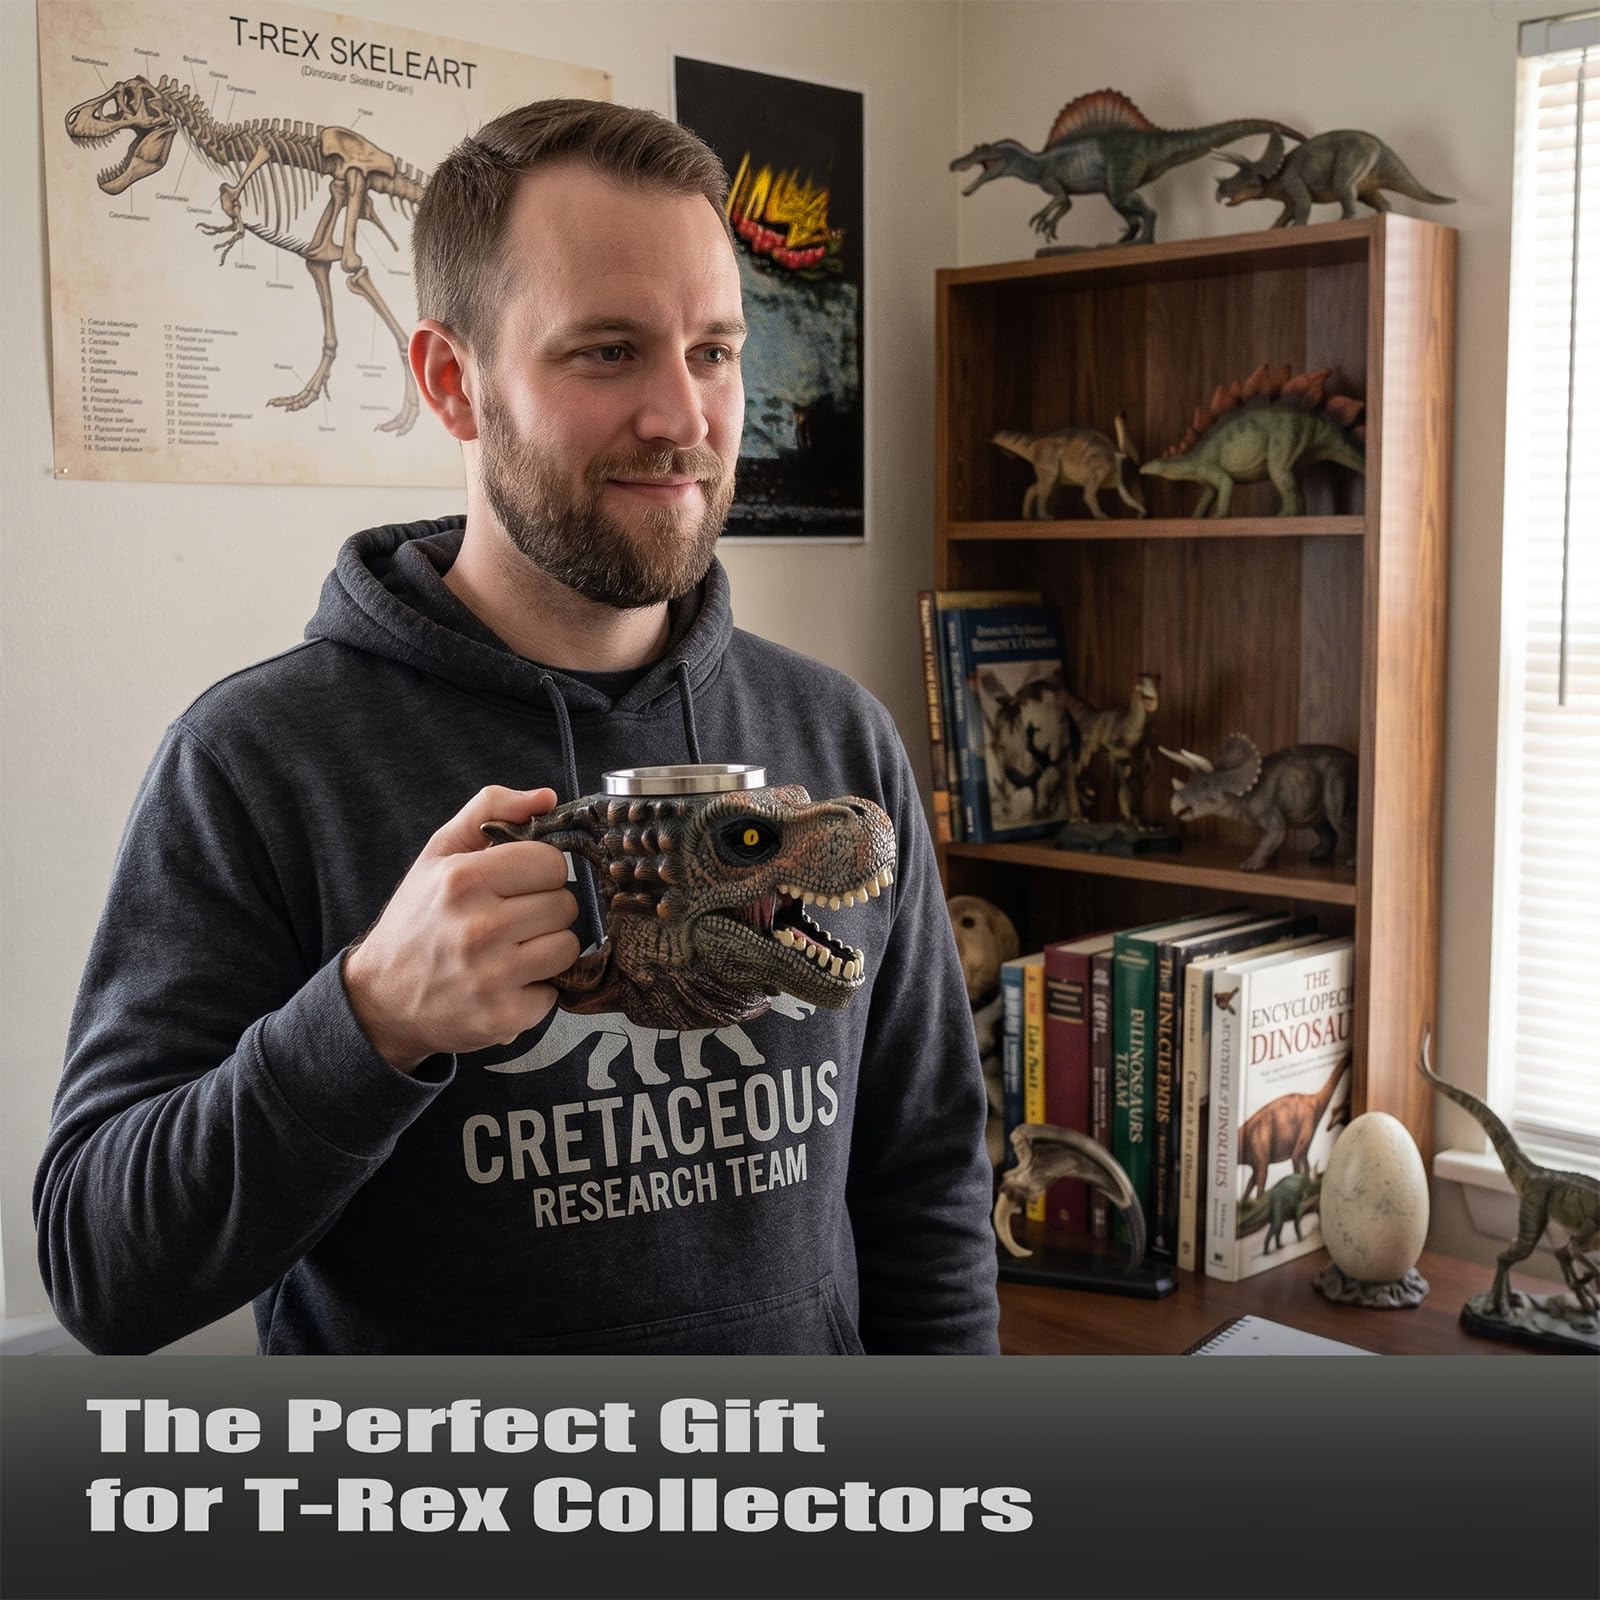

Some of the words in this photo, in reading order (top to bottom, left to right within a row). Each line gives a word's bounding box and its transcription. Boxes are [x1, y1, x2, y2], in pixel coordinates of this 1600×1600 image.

[229, 16, 320, 61] T-REX
[330, 36, 478, 89] SKELEART
[1303, 968, 1330, 991] THE
[1115, 1052, 1129, 1108] TEAM
[462, 1060, 839, 1184] CRETACEOUS
[533, 1162, 718, 1228] RESEARCH
[725, 1143, 807, 1196] TEAM
